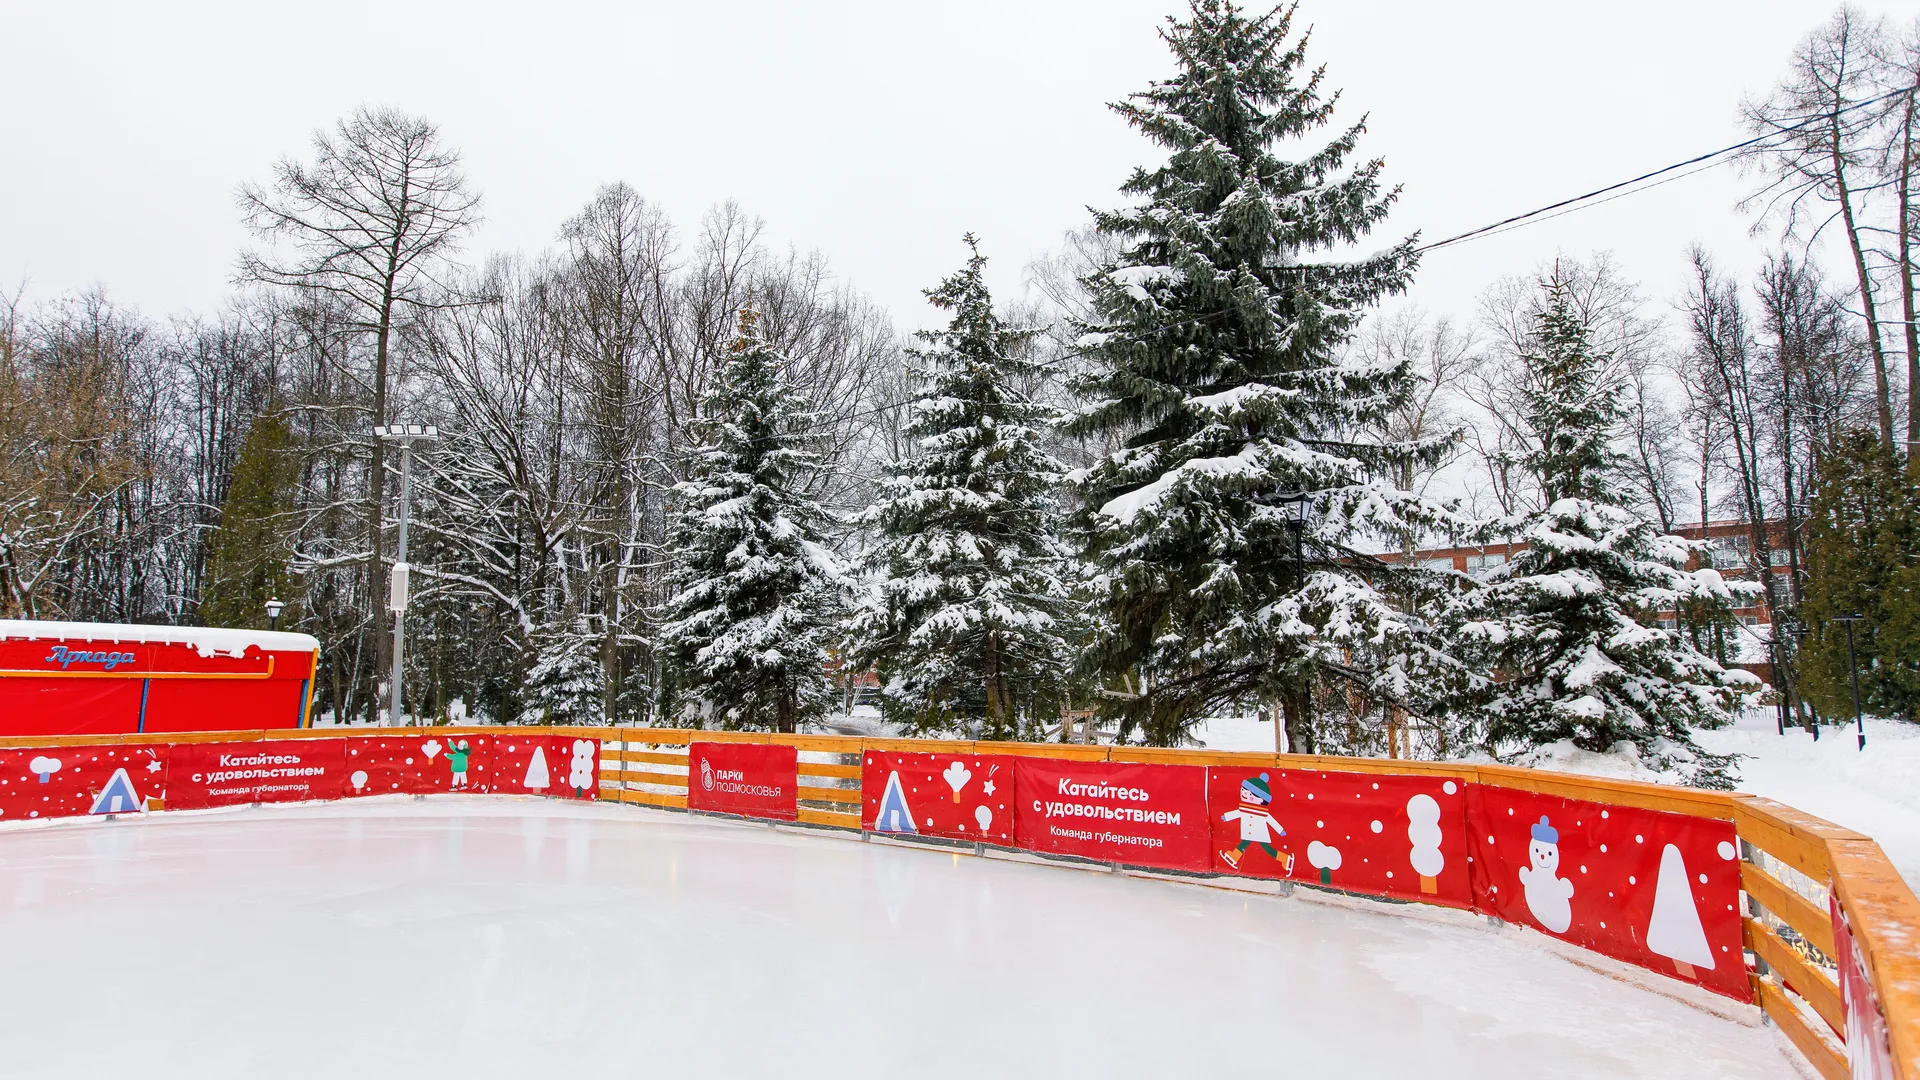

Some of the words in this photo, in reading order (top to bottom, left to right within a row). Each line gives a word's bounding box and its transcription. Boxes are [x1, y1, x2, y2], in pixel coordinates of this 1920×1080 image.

[45, 645, 136, 670] Аркада
[219, 753, 301, 767] Катайтесь
[191, 772, 202, 783] с
[205, 766, 325, 785] удовольствием
[716, 770, 743, 781] ПАРКИ
[209, 786, 250, 796] Команда
[251, 784, 310, 794] губернатора
[716, 782, 781, 797] ПОДМОСКОВЬЯ
[1057, 778, 1150, 801] Катайтесь
[1033, 800, 1041, 812] с
[1045, 801, 1181, 826] удовольствием
[1050, 825, 1092, 840] Команда
[1094, 831, 1163, 848] губернатора
